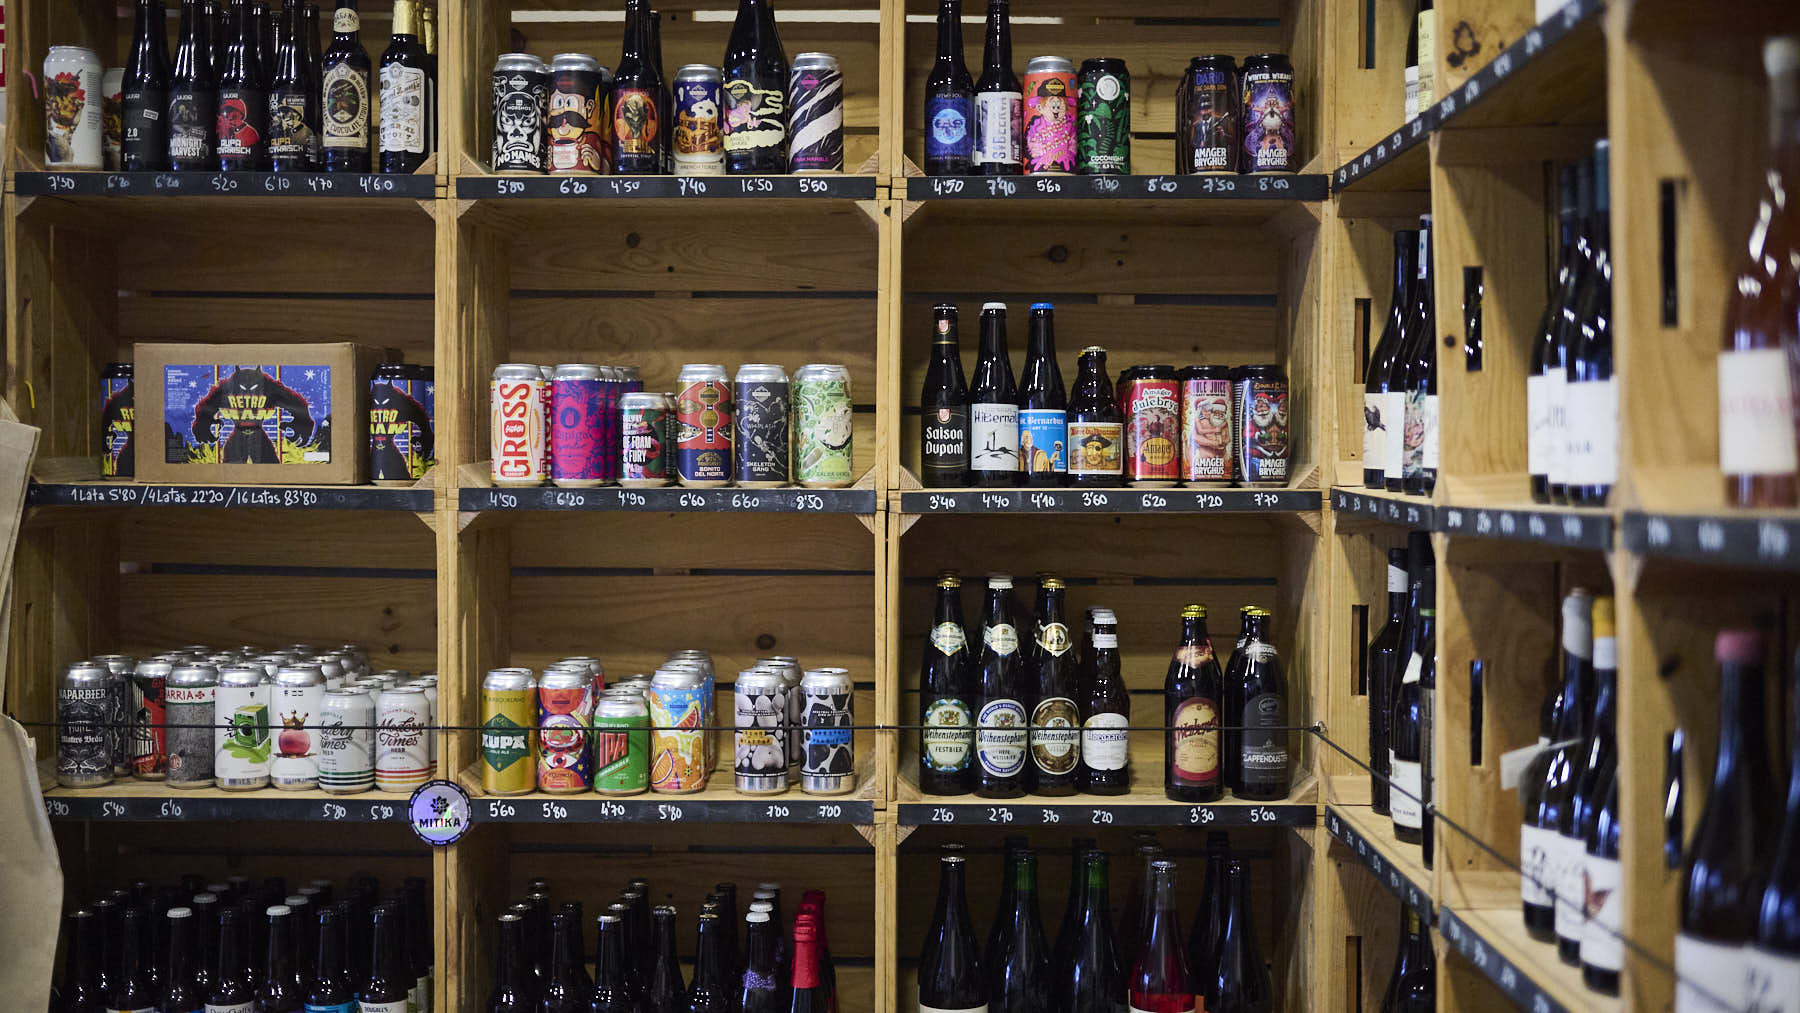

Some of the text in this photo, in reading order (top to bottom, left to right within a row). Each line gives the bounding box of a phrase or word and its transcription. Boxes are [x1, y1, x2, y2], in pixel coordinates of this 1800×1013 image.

[499, 149, 541, 168] NO MAMES
[1195, 147, 1228, 159] AMAGER
[1257, 148, 1288, 159] AMAGER
[1194, 158, 1228, 168] BRYGHUS
[1257, 158, 1288, 168] BRYGHUS
[265, 176, 290, 191] 6'10
[309, 178, 333, 191] 4'70
[360, 177, 393, 192] 4'60
[559, 178, 588, 194] 6'20
[610, 178, 641, 194] 4'50
[677, 177, 707, 195] 7'40
[741, 178, 774, 192] 16'50
[799, 178, 828, 193] 5'50
[933, 177, 965, 195] 4'50
[1036, 177, 1061, 192] 5'60
[1147, 176, 1178, 192] 8'00
[1202, 177, 1235, 192] 7'50
[1258, 176, 1289, 191] 8'00
[1210, 381, 1227, 394] JUICE
[226, 394, 267, 409] RETRO
[500, 383, 531, 477] GROSS
[925, 426, 964, 441] Saison
[622, 436, 652, 449] OF FOAM
[924, 441, 964, 458] Dupont
[629, 450, 647, 463] FURY
[1194, 458, 1225, 468] AMAGER
[1259, 458, 1287, 468] AMAGER
[109, 490, 136, 500] 5'80
[190, 489, 224, 503] 22'20
[284, 490, 317, 506] 83'80
[490, 491, 518, 508] 4'50
[556, 491, 585, 507] 6'20
[617, 490, 645, 507] 4'90
[679, 493, 705, 507] 6'60
[732, 494, 759, 508] 6'60
[929, 492, 956, 510] 3'40
[982, 492, 1009, 508] 4'40
[1082, 491, 1108, 506] 3'60
[1141, 493, 1167, 508] 6'20
[1254, 493, 1279, 507] 7'70
[375, 717, 425, 736] Modern
[379, 732, 418, 747] Times
[600, 731, 628, 769] IPA
[102, 802, 126, 816] 5'40
[161, 800, 182, 816] 6'10
[323, 803, 346, 819] 5'80
[370, 804, 394, 820] 5'80
[490, 800, 515, 817] 5'60
[543, 802, 567, 819] 5'80
[601, 802, 625, 817] 4'70
[659, 805, 683, 821] 5'80
[767, 806, 789, 818] 7'00
[819, 806, 841, 818] 7'00
[932, 807, 954, 822] 2'60
[989, 807, 1013, 822] 2'70
[1190, 807, 1214, 823] 3'30
[1251, 806, 1276, 822] 5'00
